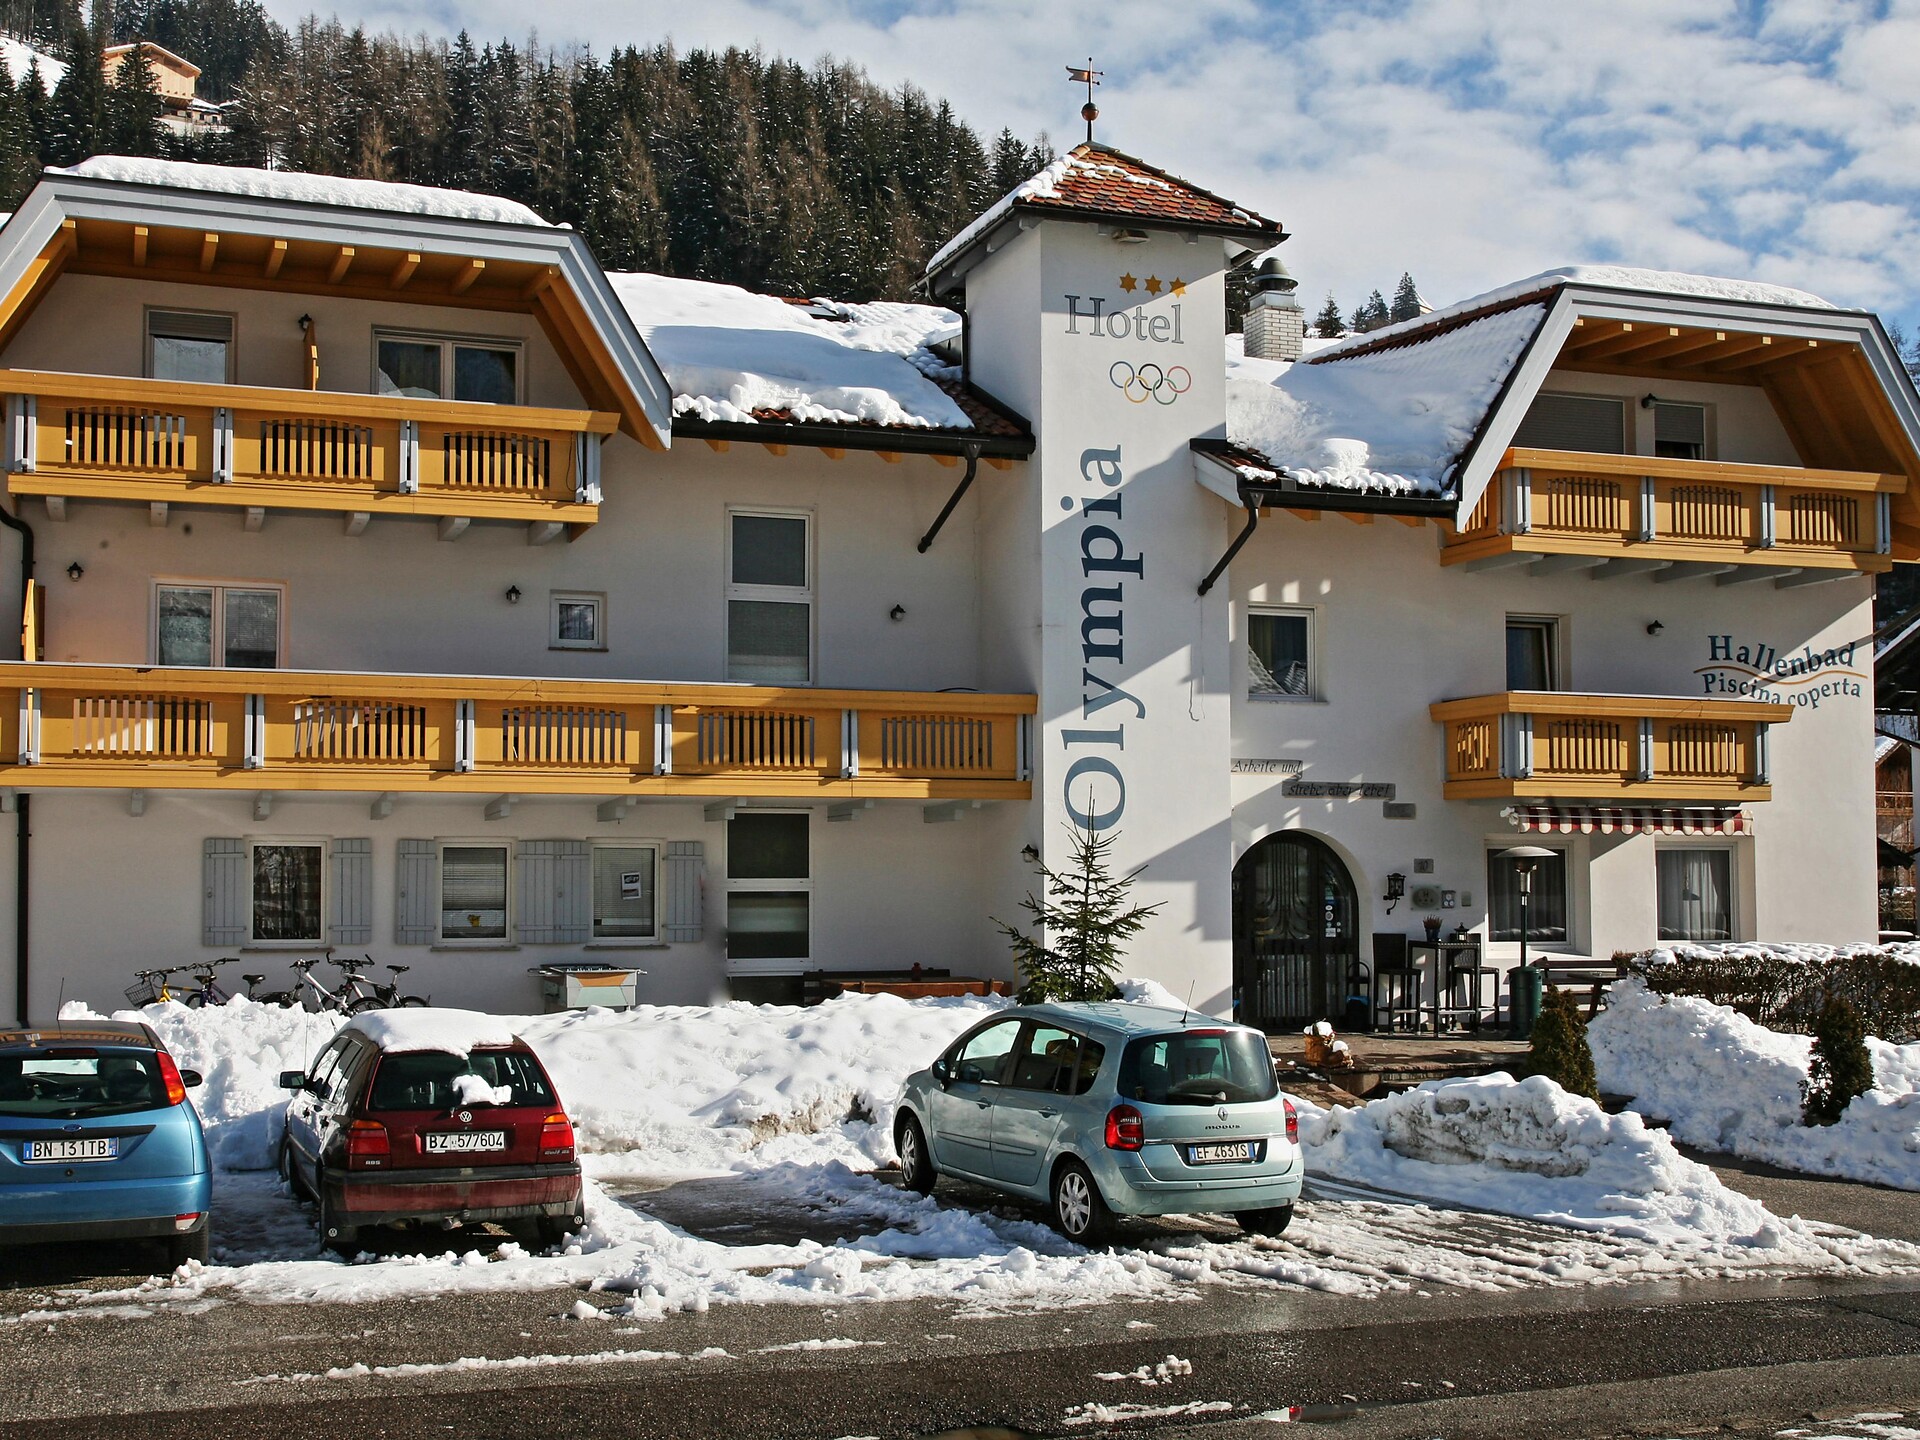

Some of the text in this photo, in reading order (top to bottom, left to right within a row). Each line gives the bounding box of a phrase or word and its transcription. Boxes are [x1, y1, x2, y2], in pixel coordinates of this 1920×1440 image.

[1064, 294, 1185, 345] Hotel
[1060, 443, 1146, 832] Olympia
[1707, 635, 1856, 678] Hallenbad
[1702, 672, 1861, 710] Piscina coperta
[33, 1142, 53, 1158] BN
[60, 1140, 107, 1157] 131TB
[429, 1133, 503, 1149] BZ 577604
[1196, 1146, 1210, 1159] EF
[1214, 1143, 1248, 1159] 463YS
